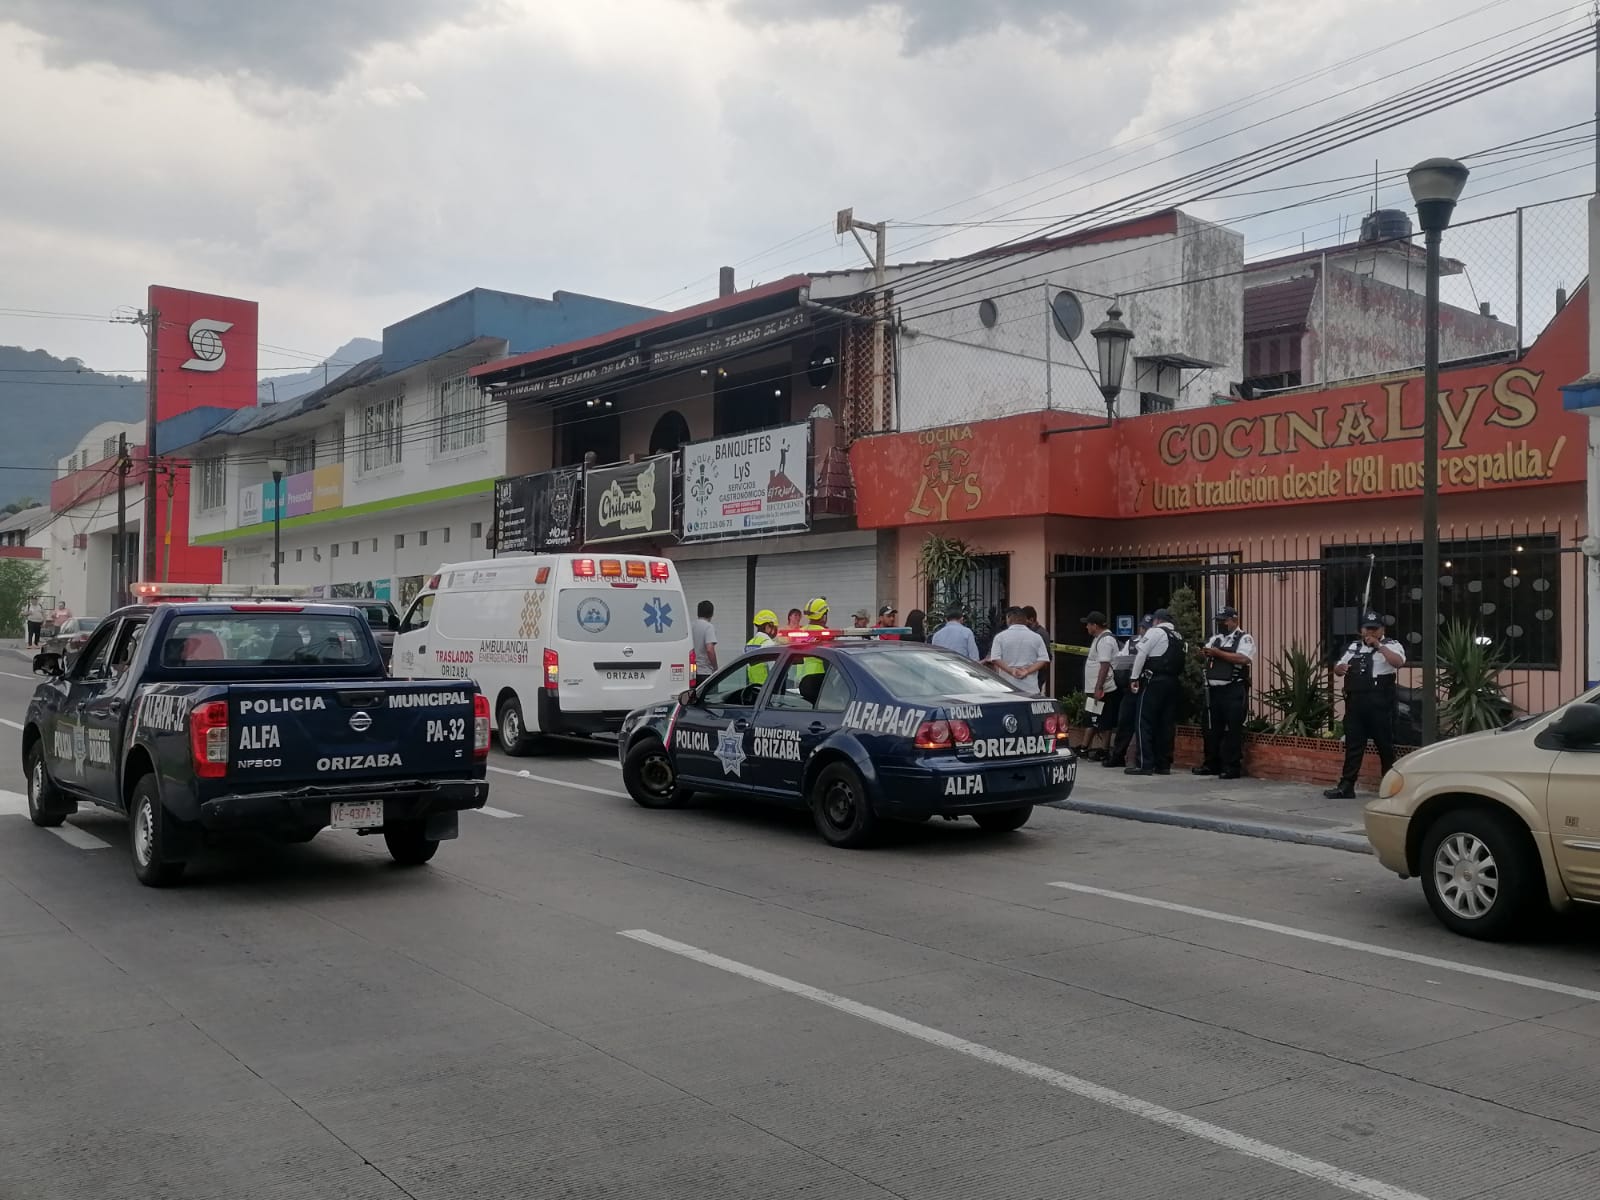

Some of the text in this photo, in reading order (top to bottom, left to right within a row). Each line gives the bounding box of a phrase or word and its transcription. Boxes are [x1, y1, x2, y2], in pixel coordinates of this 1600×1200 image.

[918, 425, 974, 445] COCINA
[1158, 401, 1379, 466] COCINA
[715, 435, 771, 460] BANQUETES
[734, 461, 751, 482] LyS
[1194, 465, 1279, 507] tradición
[1282, 460, 1341, 500] desde
[1345, 455, 1384, 496] 1981
[728, 481, 756, 492] SERVICIOS
[435, 650, 474, 664] TRASLADOS
[479, 640, 529, 654] AMBULANCIA
[517, 654, 528, 664] 911
[441, 664, 469, 678] ORIZABA
[606, 671, 646, 680] ORIZABA
[240, 692, 469, 714] POLICIA MUNICIPAL
[950, 704, 984, 720] POLICIA
[841, 700, 927, 738] ALFA-PA-07
[239, 718, 466, 750] ALFA PA-32
[675, 730, 710, 751] POLICIA
[754, 726, 802, 742] MUNICIPAL
[753, 738, 801, 761] ORIZABA
[973, 736, 1047, 759] ORIZABA
[316, 753, 403, 771] ORIZABA
[1052, 763, 1078, 785] PA-07
[944, 774, 984, 796] ALFA
